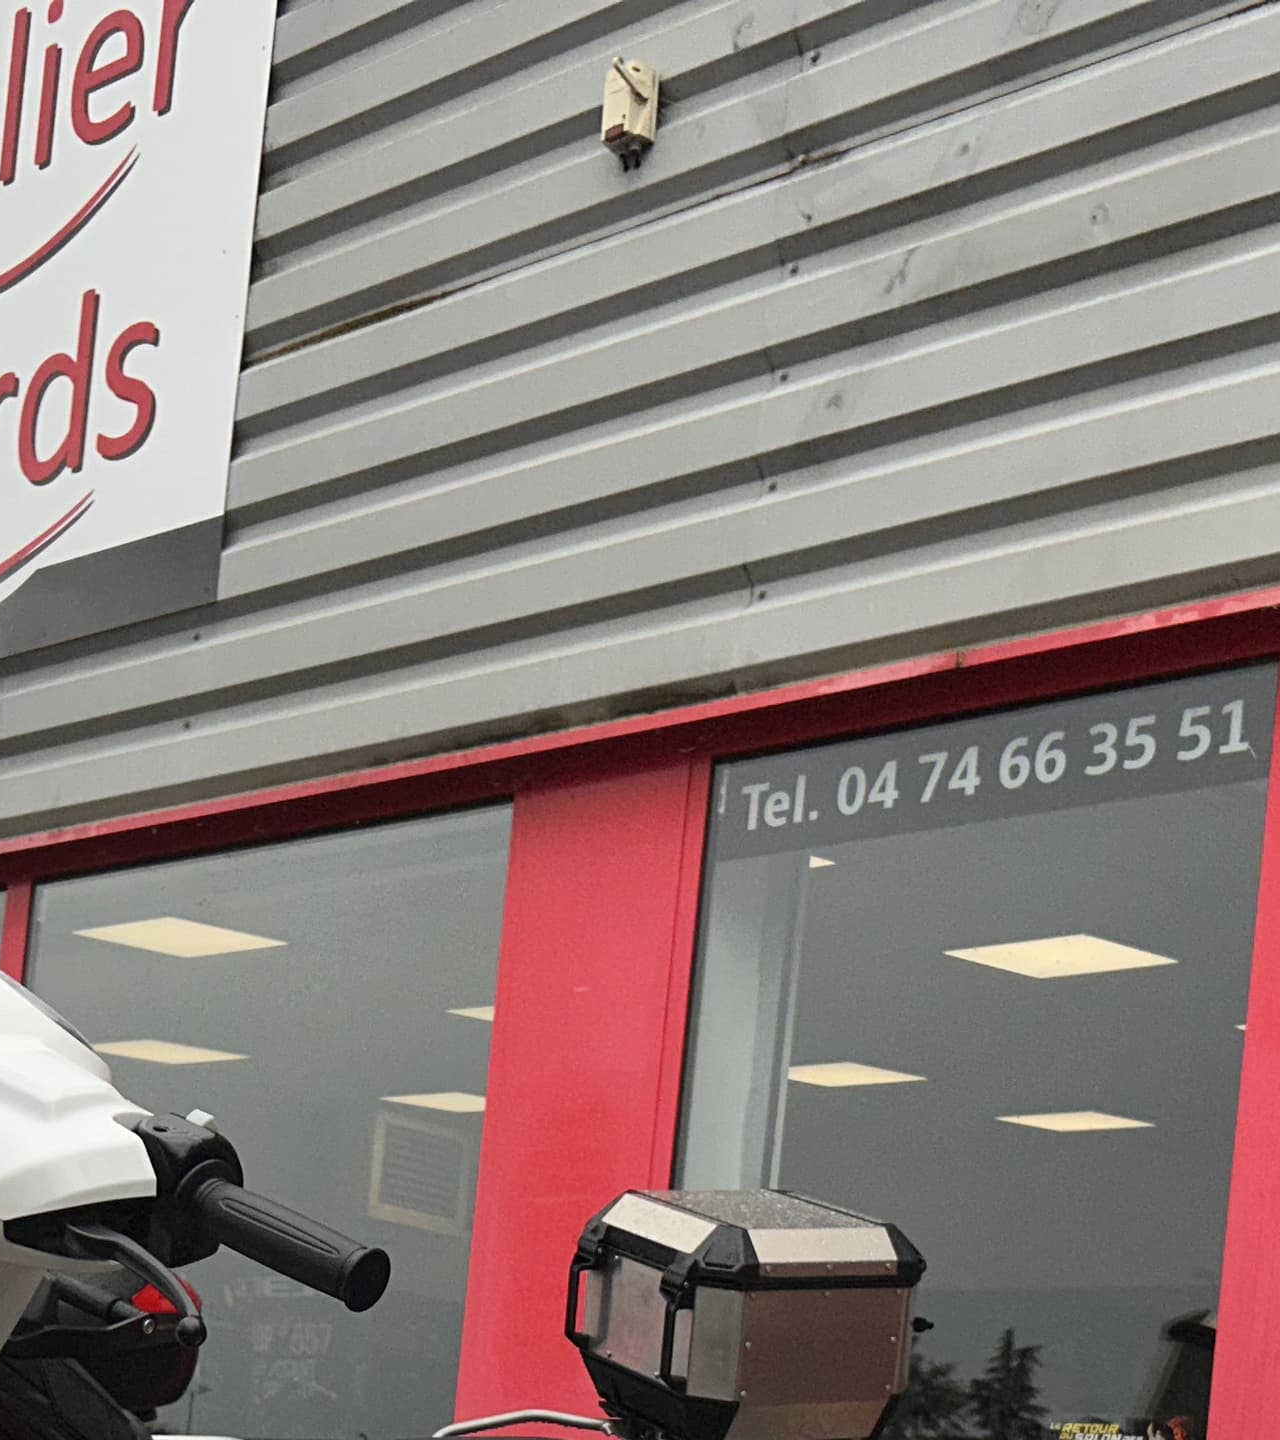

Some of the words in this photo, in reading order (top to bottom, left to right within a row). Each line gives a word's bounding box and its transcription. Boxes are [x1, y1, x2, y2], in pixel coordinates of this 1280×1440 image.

[741, 774, 819, 831] Tel.
[837, 760, 899, 816] 04
[918, 745, 982, 803] 74
[998, 731, 1066, 790] 66
[1083, 715, 1156, 776] 35
[1176, 698, 1250, 761] 51
[1062, 1422, 1121, 1434] RETOUR
